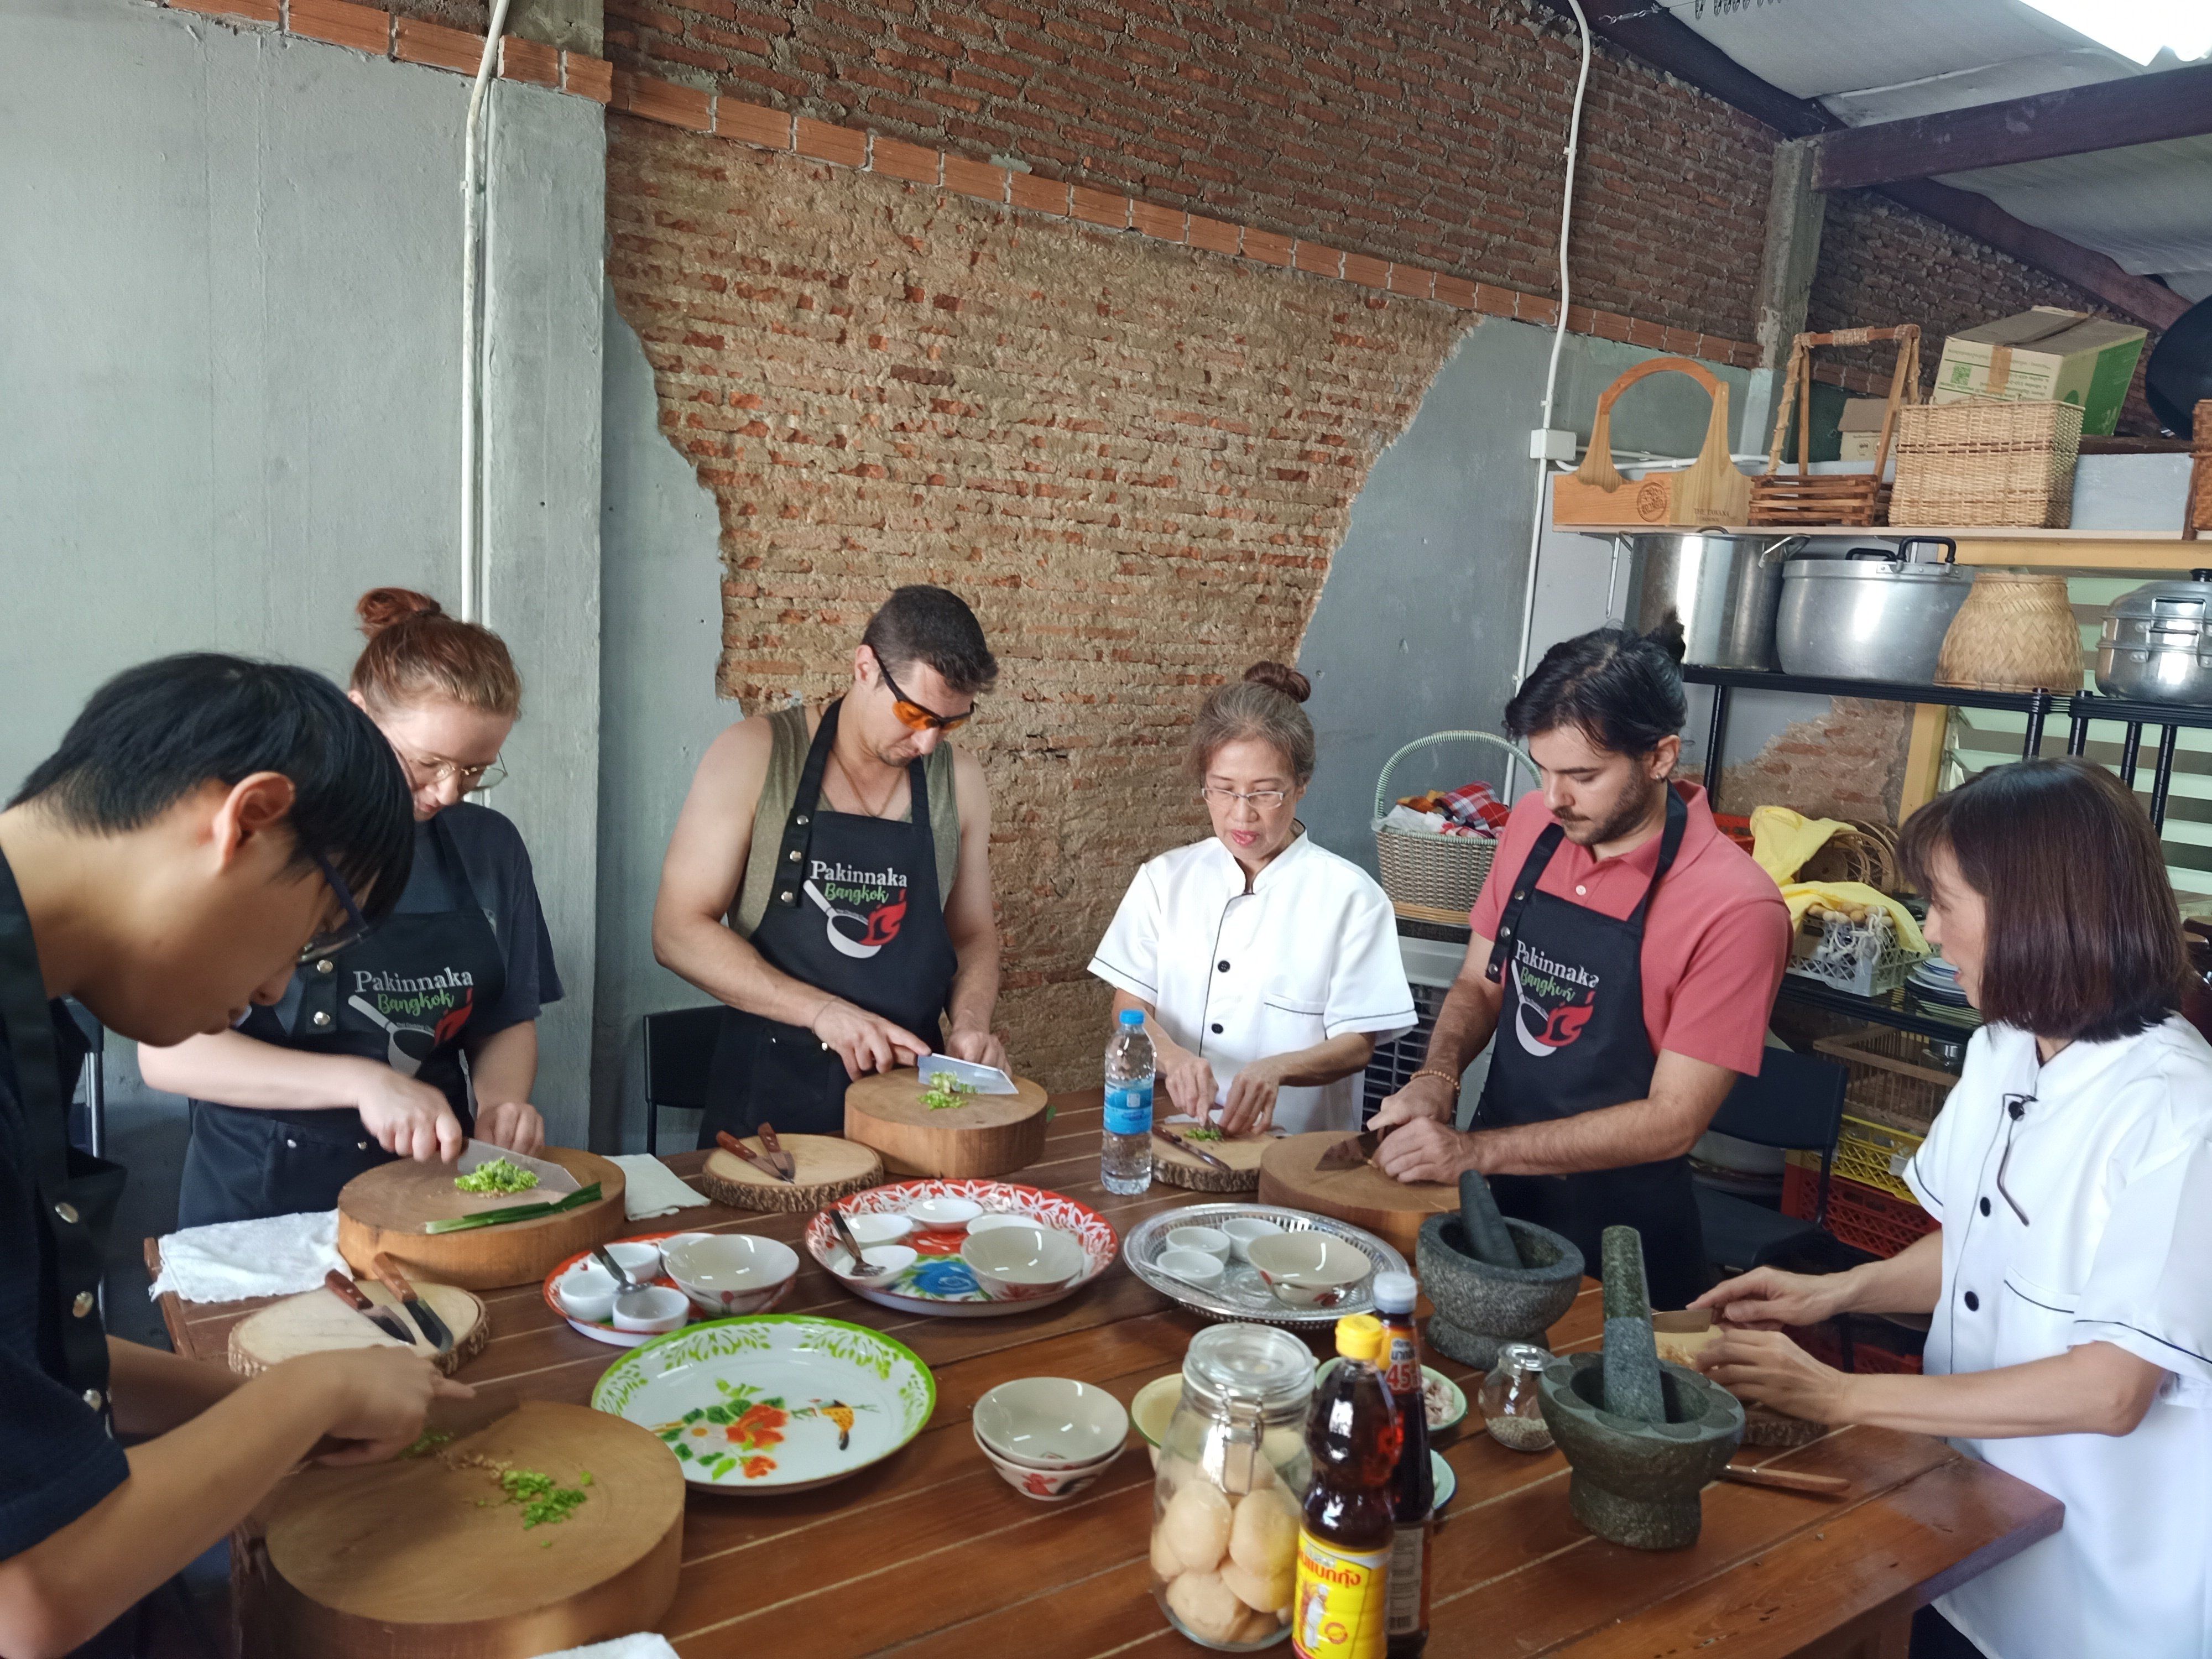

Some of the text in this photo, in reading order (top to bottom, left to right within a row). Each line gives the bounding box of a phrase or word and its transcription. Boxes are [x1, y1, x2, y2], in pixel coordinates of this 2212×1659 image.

[810, 860, 907, 887] Pakinnaka
[825, 883, 889, 905] Bangkok
[1515, 939, 1599, 988] Pakinnaka
[353, 967, 473, 993] Pakinnaka
[378, 989, 454, 1016] Bangkok
